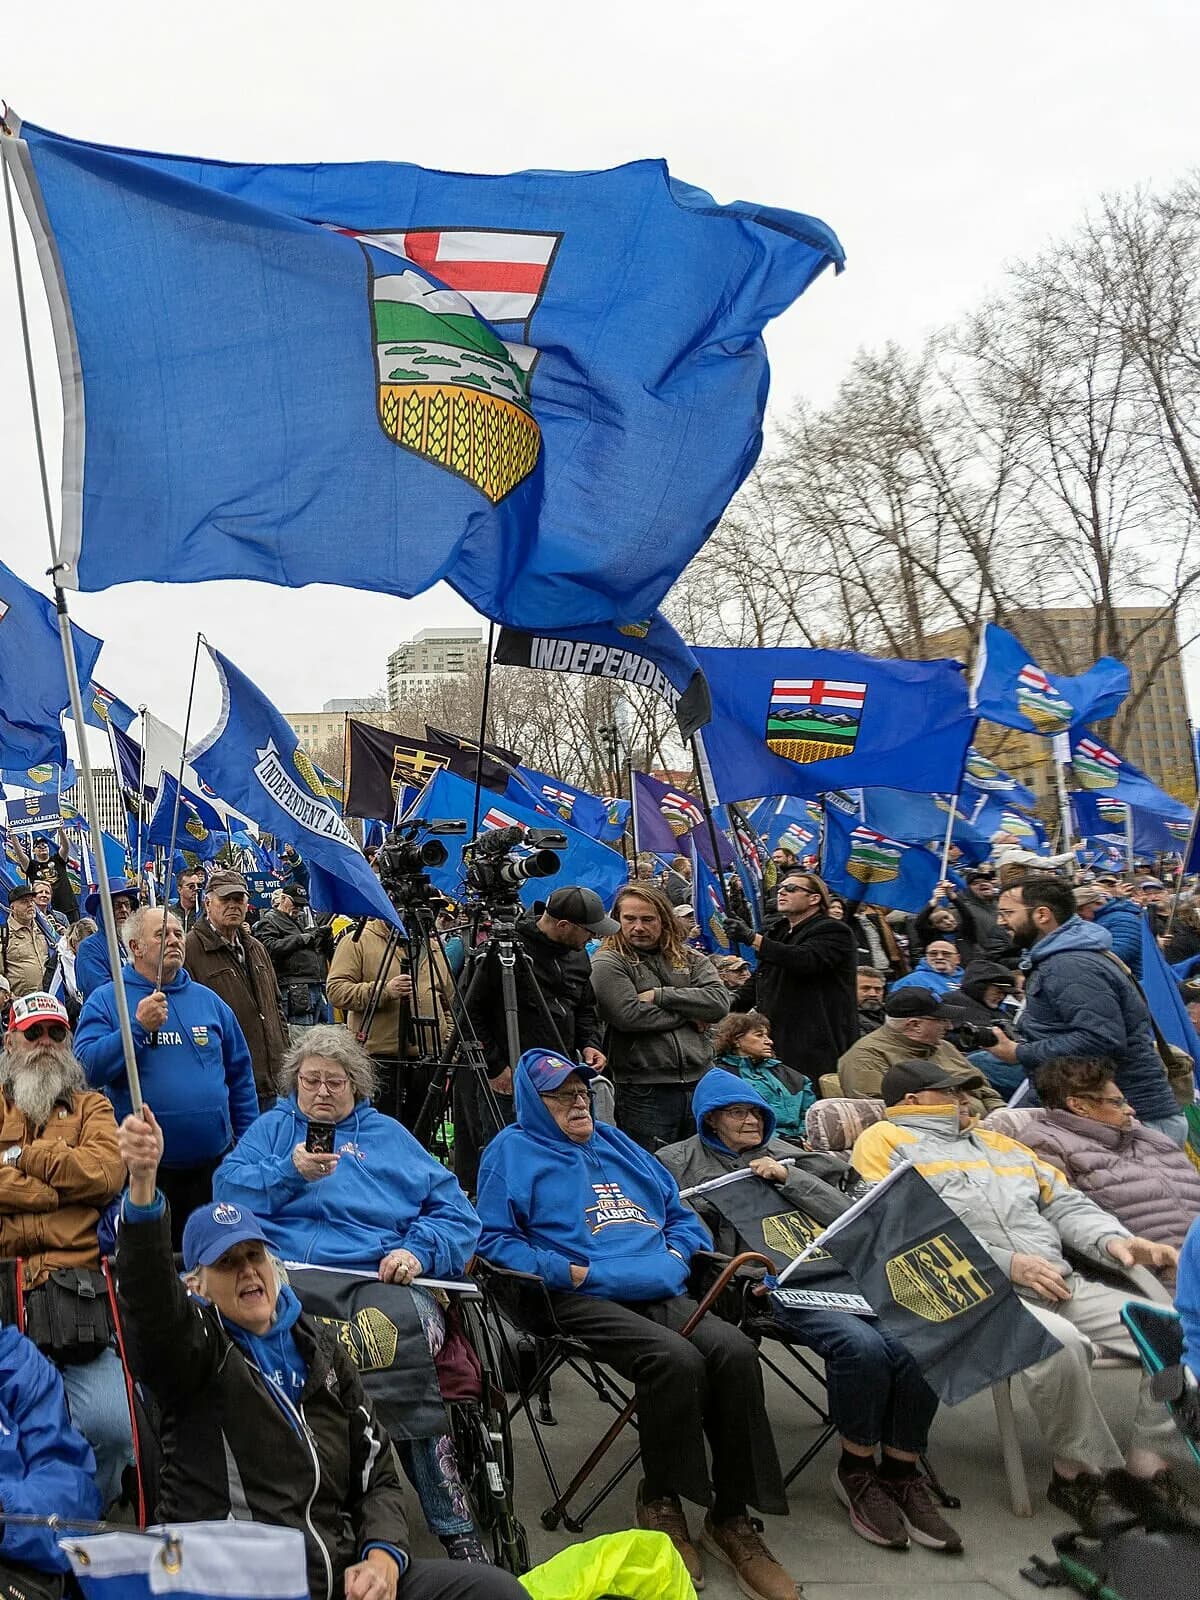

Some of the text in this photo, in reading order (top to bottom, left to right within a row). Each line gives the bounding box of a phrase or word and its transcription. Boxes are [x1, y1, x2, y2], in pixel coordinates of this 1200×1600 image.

[260, 759, 328, 829] INDEPENDENT
[10, 813, 60, 825] CHOOSE ALBERTA
[265, 880, 281, 888] VOTE
[596, 1208, 648, 1224] ALBERTA
[777, 1290, 852, 1307] FOREVER
